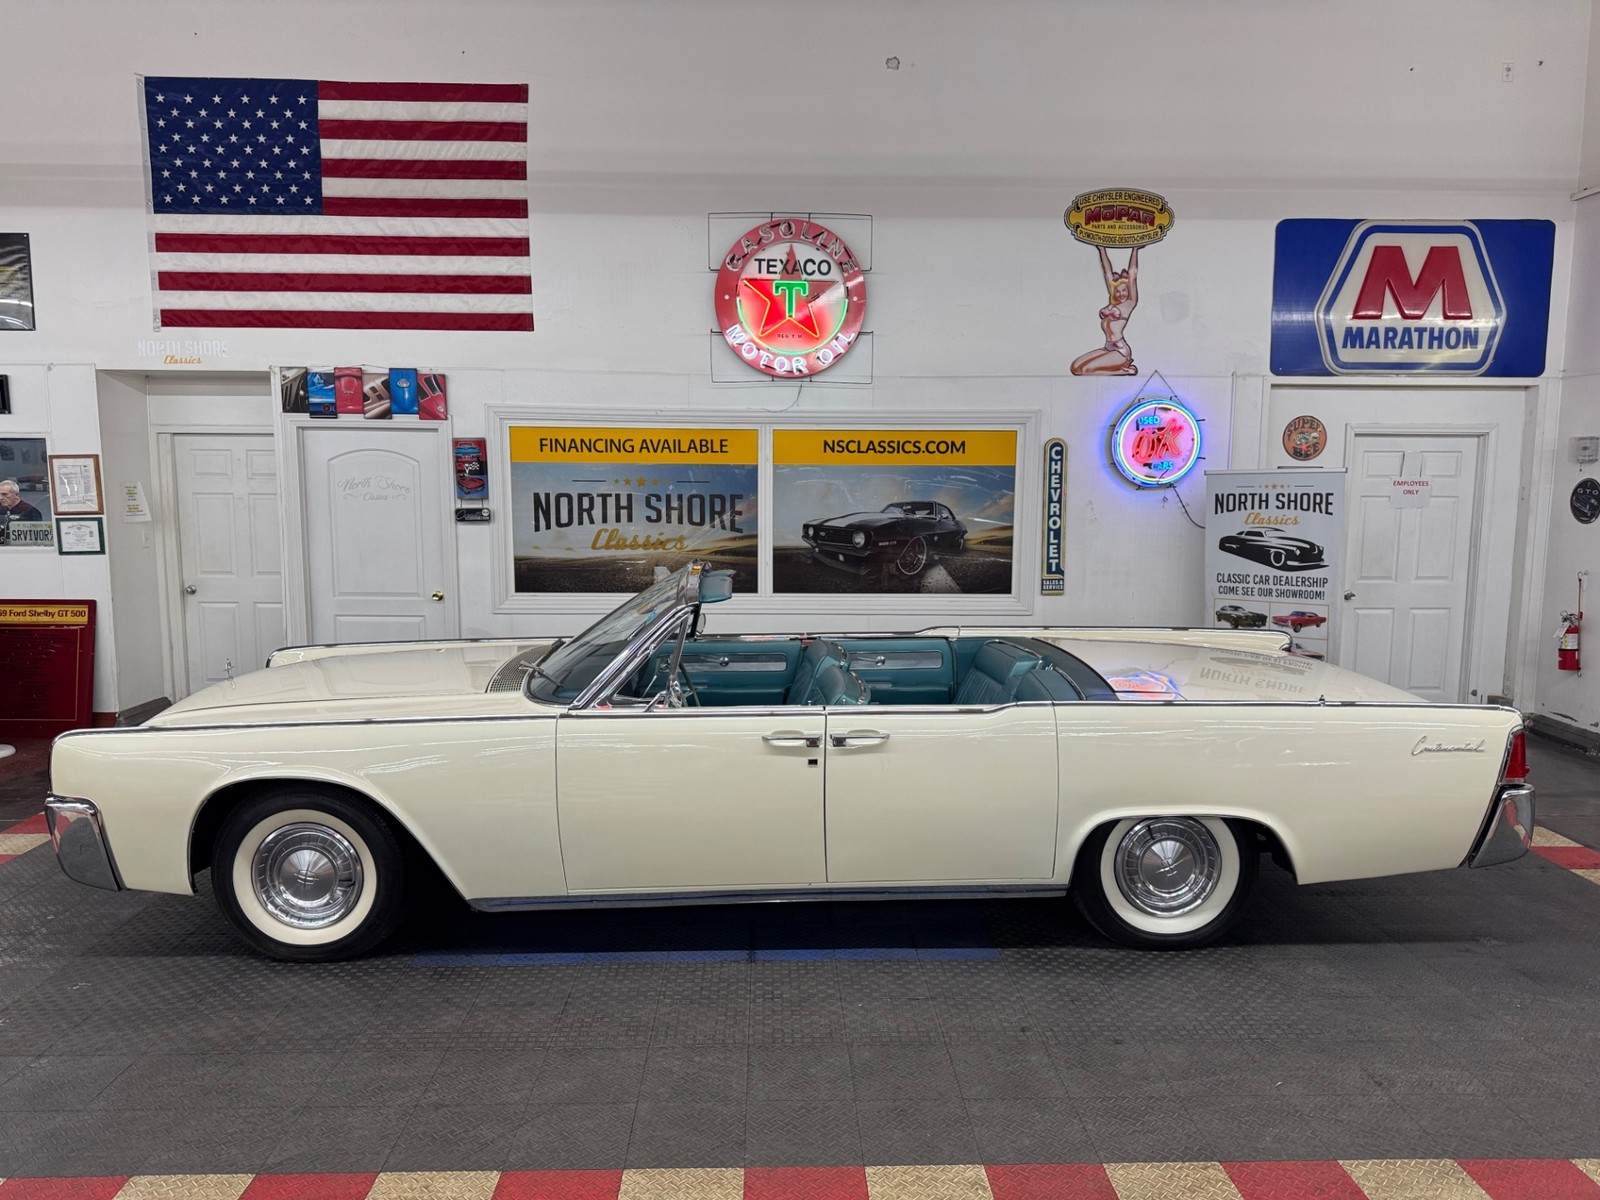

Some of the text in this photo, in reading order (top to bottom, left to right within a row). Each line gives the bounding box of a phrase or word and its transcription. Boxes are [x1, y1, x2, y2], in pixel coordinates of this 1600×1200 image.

[1079, 192, 1160, 206] USE CHRYSLER ENGINEERED
[1085, 205, 1156, 227] MOPAR
[726, 220, 858, 276] GASOLINE
[754, 258, 831, 276] TEXACO
[1353, 246, 1473, 320] M
[773, 280, 809, 318] T
[1342, 326, 1479, 350] MARATHON
[138, 340, 228, 358] NORTH SHORE
[726, 324, 855, 374] MOTOR OIL
[164, 355, 202, 364] Classics
[1138, 416, 1160, 425] USED
[539, 438, 729, 454] FINANCING AVAILABLE
[823, 440, 966, 455] NSCLASSICS.COM
[1577, 487, 1599, 496] GTO
[533, 492, 744, 533] NORTH SHORE
[1048, 447, 1062, 571] CHEVROLET
[1214, 493, 1334, 516] NORTH SHORE
[1244, 512, 1300, 526] Classics
[591, 527, 689, 550] Classics
[1216, 573, 1329, 589] CLASSIC CAR DEALERSHIP
[1218, 586, 1325, 601] COME SEE OUR SHOWROOM!
[9, 609, 27, 617] Ford
[28, 608, 56, 619] Shelby
[57, 609, 70, 617] GT
[70, 609, 87, 618] 500
[1411, 735, 1485, 757] Continental
